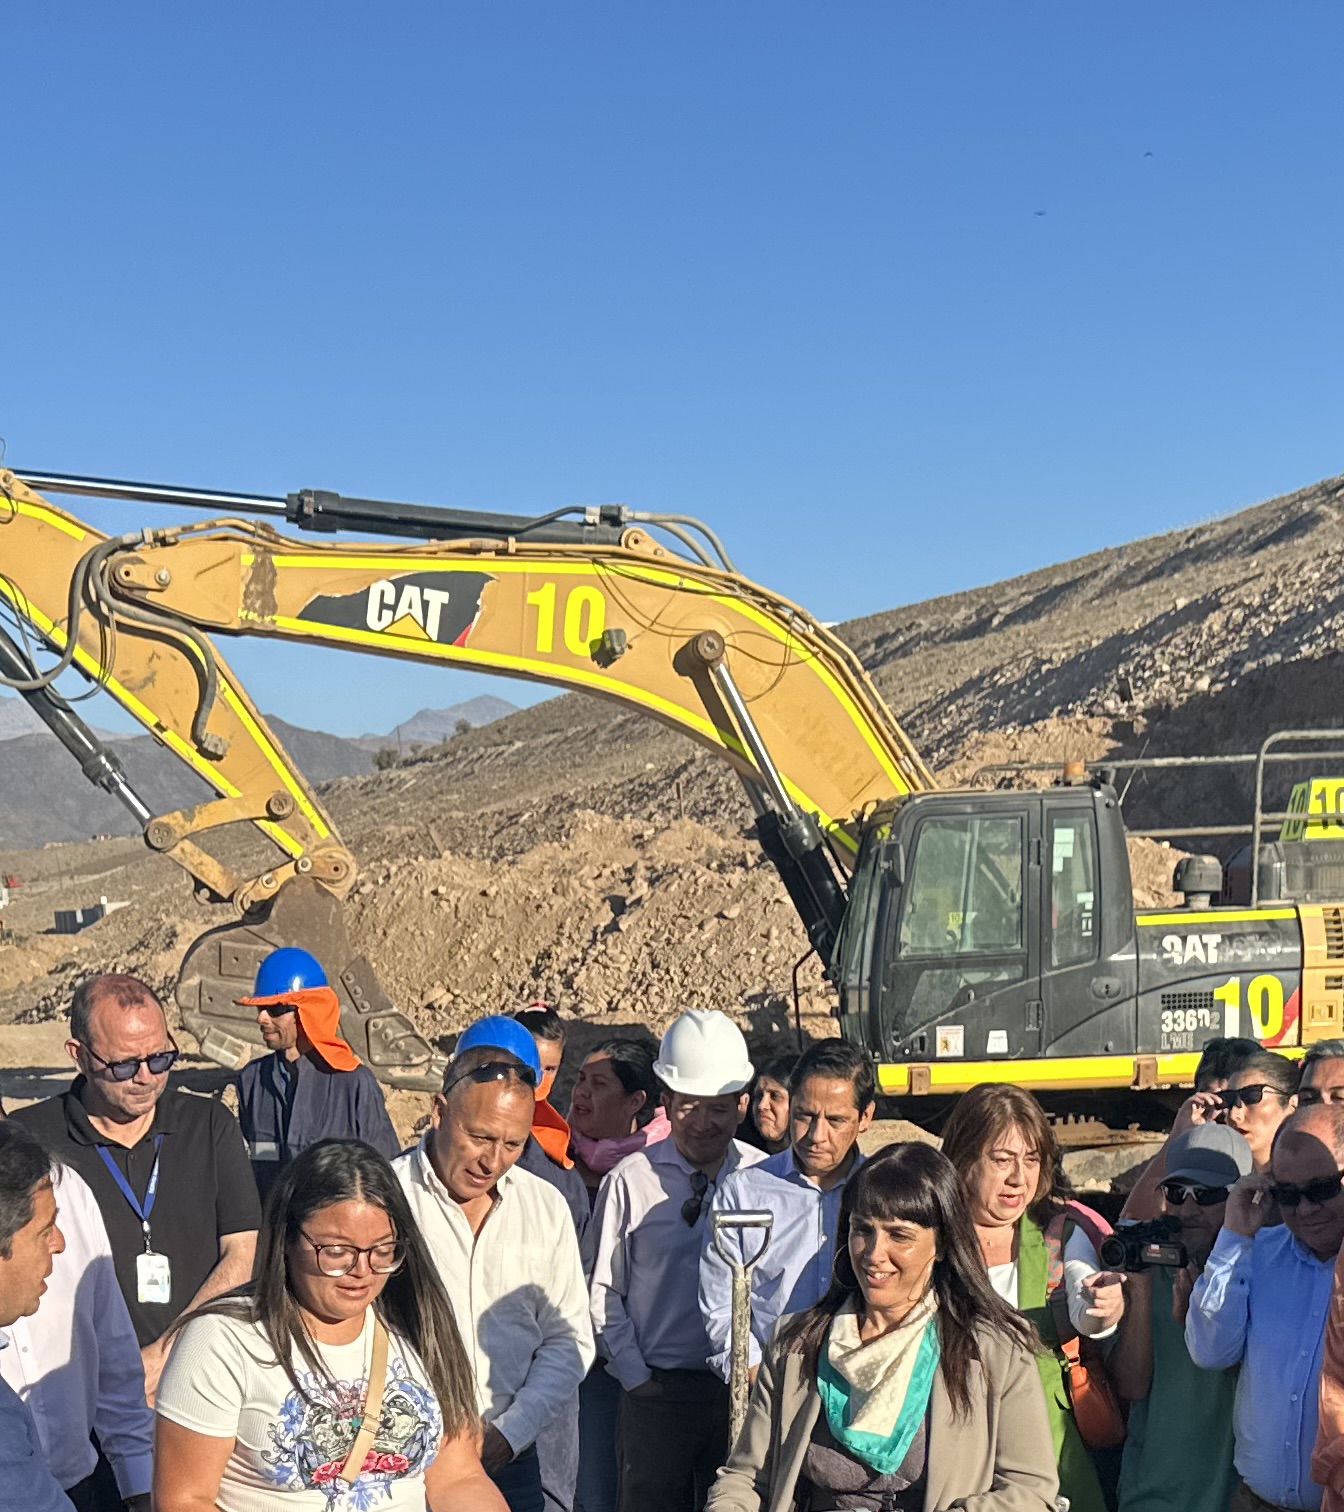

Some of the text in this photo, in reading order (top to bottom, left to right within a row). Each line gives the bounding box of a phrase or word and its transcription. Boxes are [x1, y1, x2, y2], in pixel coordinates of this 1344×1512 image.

[366, 579, 449, 642] CAT
[526, 581, 606, 656] 10
[1213, 974, 1284, 1039] 10
